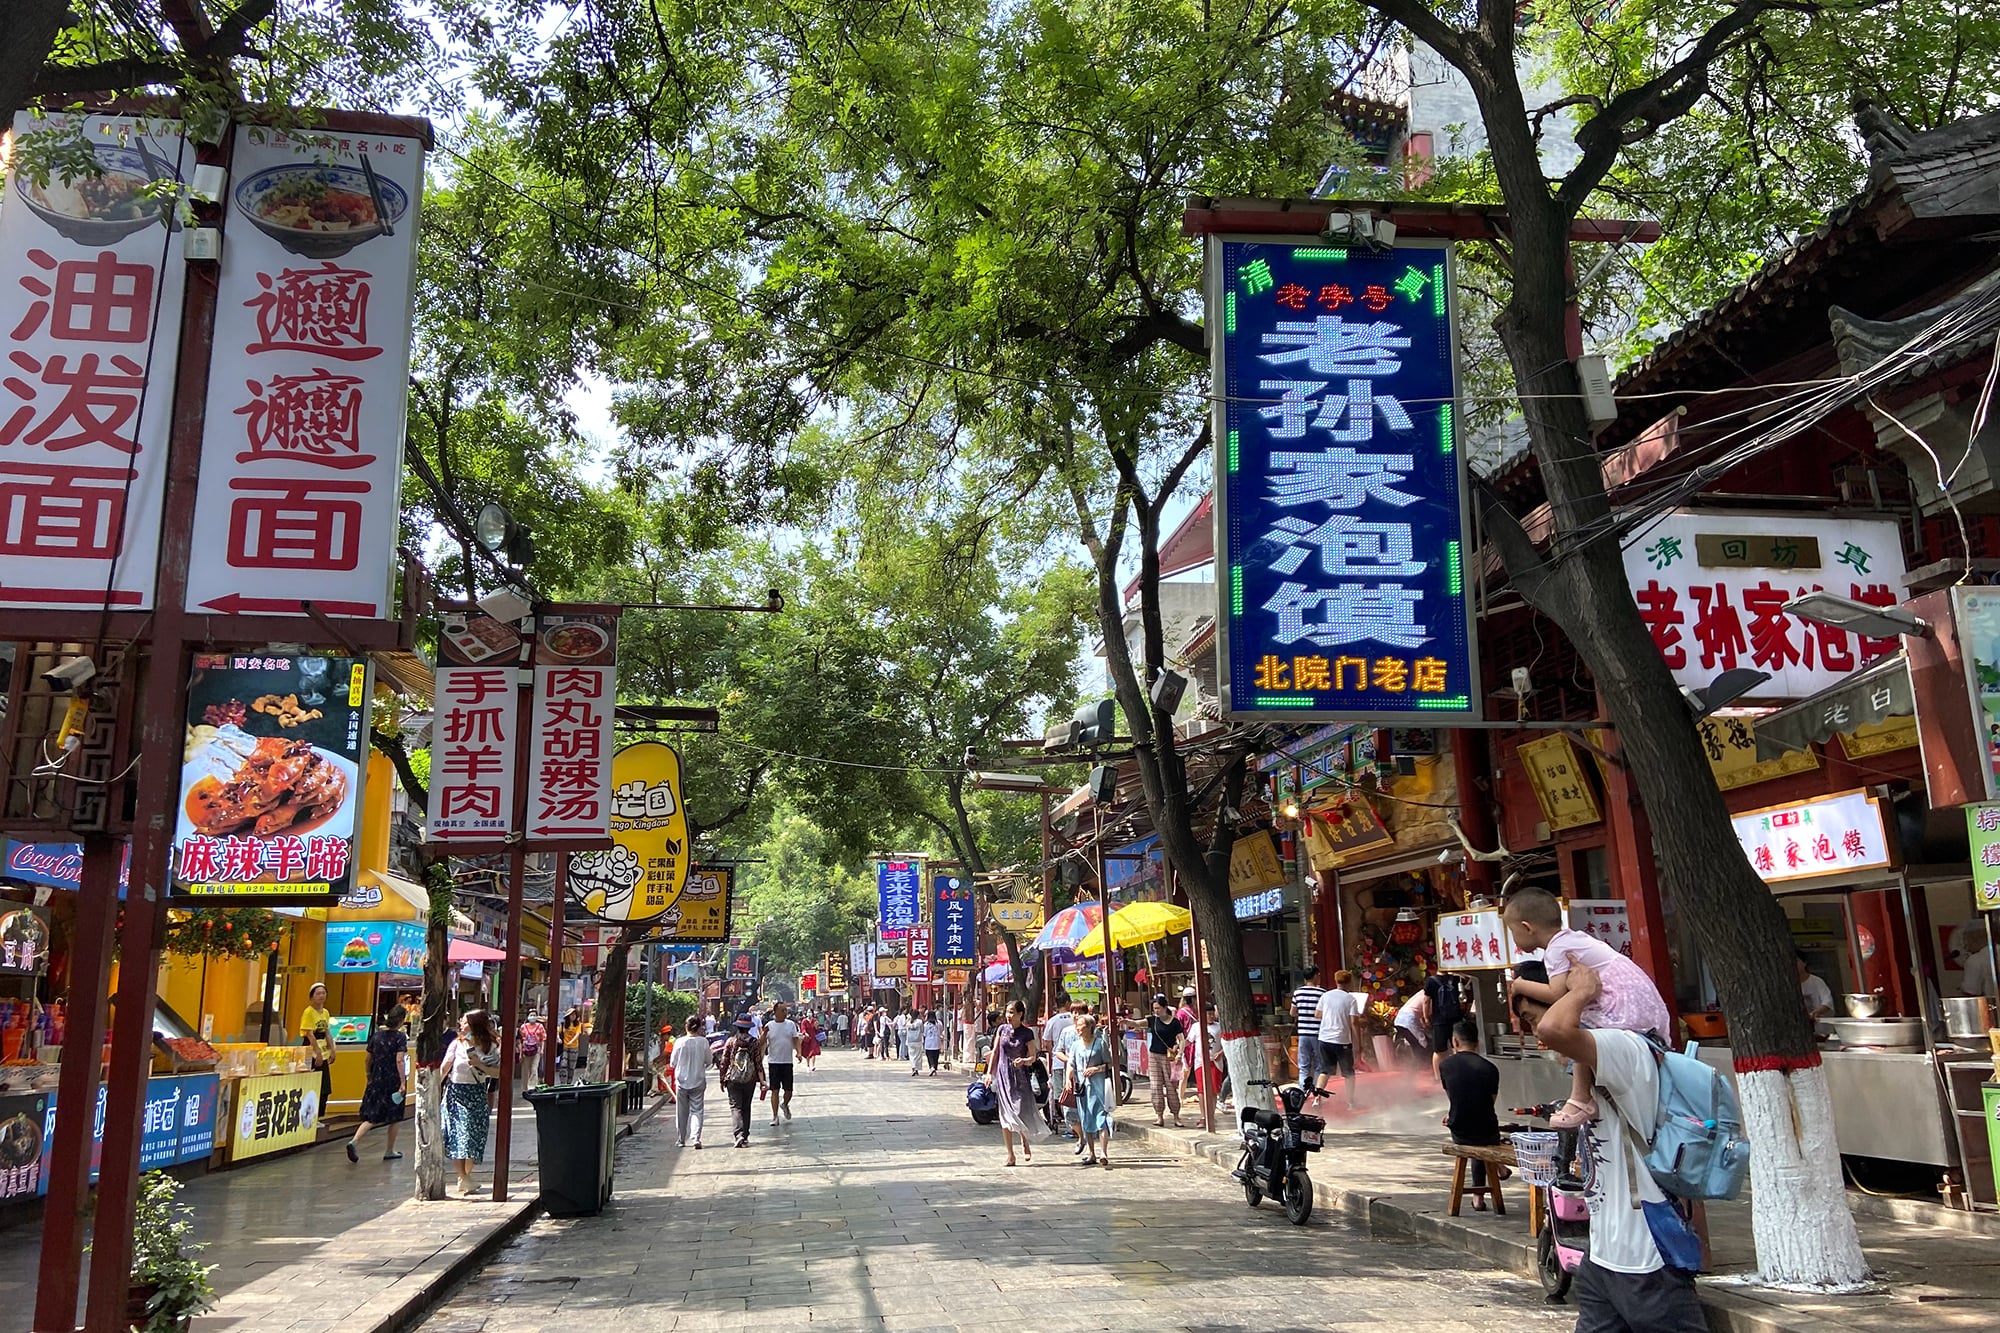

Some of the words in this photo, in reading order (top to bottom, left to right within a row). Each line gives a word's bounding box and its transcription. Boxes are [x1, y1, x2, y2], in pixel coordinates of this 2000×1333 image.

[1238, 257, 1276, 296] 清
[1394, 264, 1432, 302] 真
[1275, 281, 1396, 312] 老字号
[0, 250, 156, 560] 油泼面
[1255, 313, 1437, 649] 老孙家泡馍
[1645, 536, 1683, 570] 清
[1721, 537, 1799, 568] 回坊
[1834, 540, 1873, 576] 真
[234, 657, 291, 671] 西安名吃
[1253, 655, 1449, 694] 北院门老店
[440, 669, 509, 819] 手抓羊肉
[538, 667, 604, 820] 肉丸胡辣汤
[611, 818, 630, 832] ango
[632, 818, 670, 831] Kingdom
[178, 834, 349, 882] 麻辣羊蹄
[647, 858, 676, 868] 芒果酥
[646, 883, 674, 894] 伴手礼
[646, 896, 665, 906] 甜品
[910, 929, 929, 939] 天福
[946, 901, 964, 956] 风干牛肉干
[910, 940, 929, 976] 民宿
[255, 1087, 303, 1141] 雪花酥
